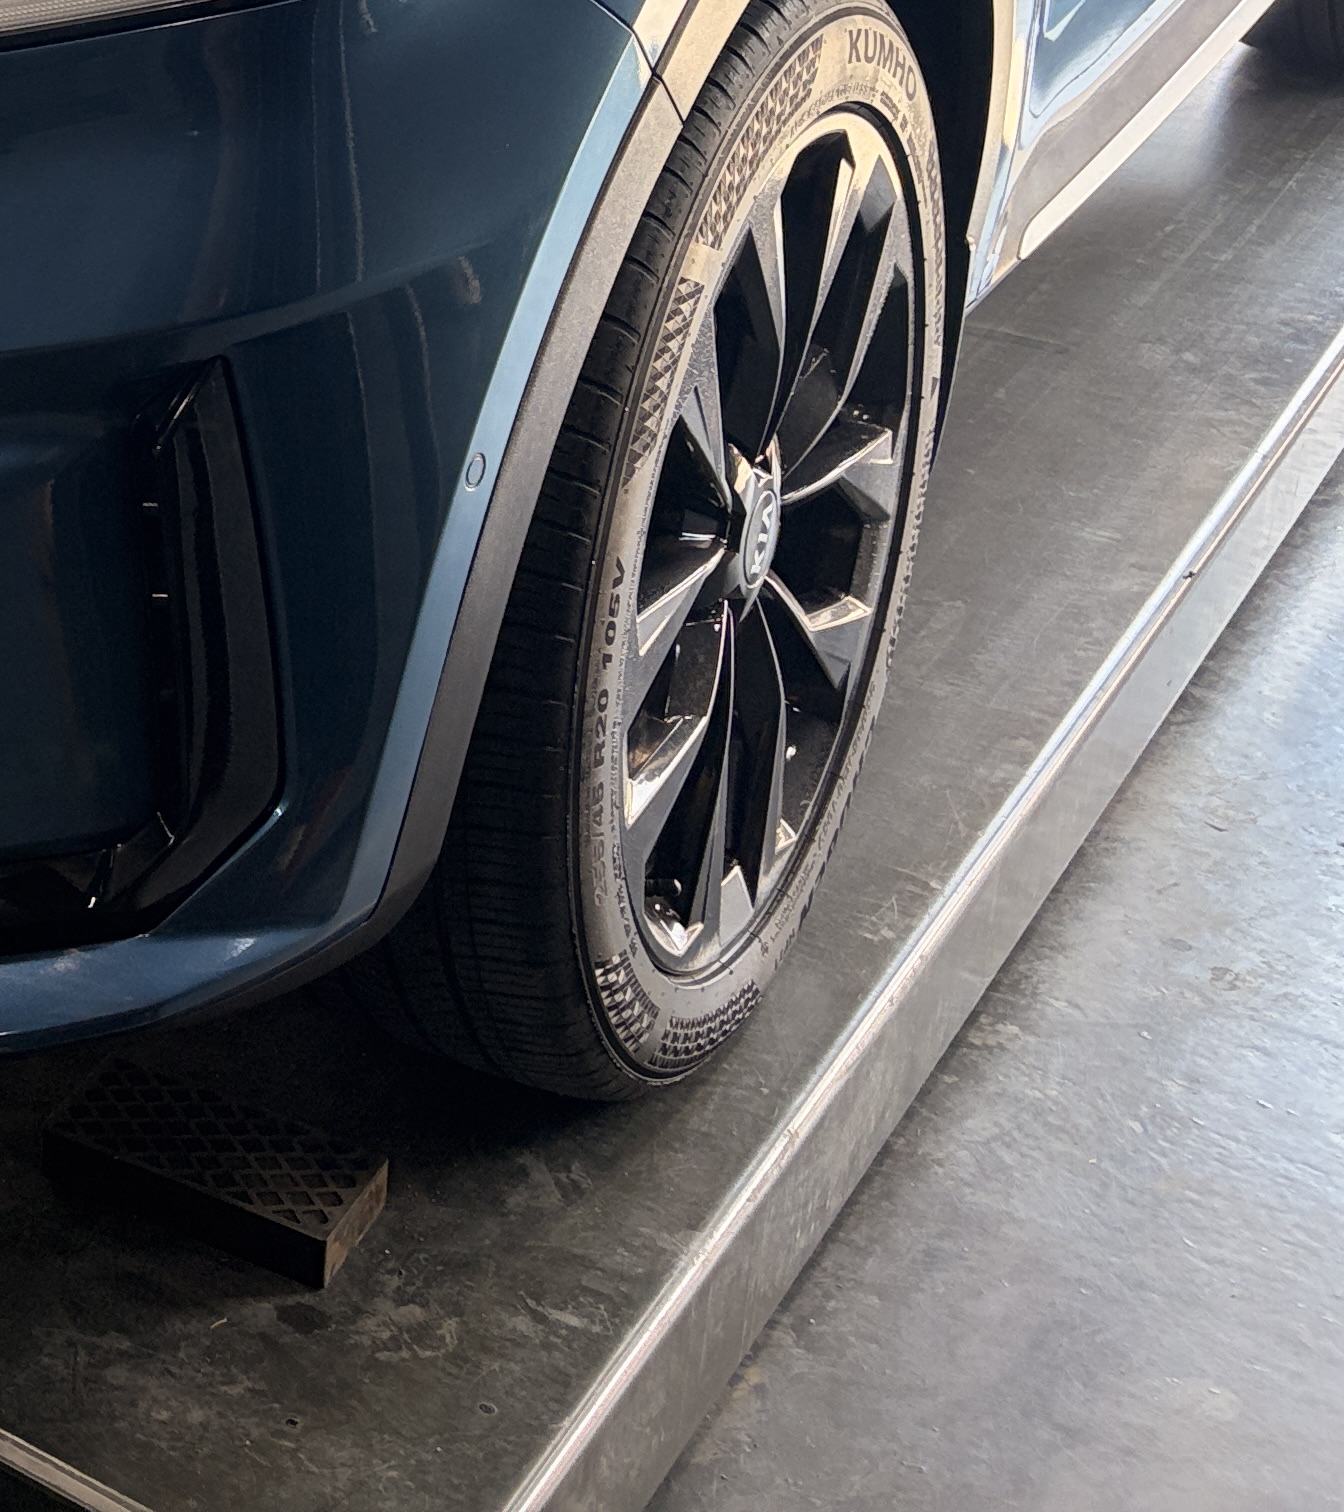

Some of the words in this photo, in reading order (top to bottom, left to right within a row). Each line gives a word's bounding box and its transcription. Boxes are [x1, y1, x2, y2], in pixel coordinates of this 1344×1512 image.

[847, 28, 917, 102] KUMHO
[593, 688, 609, 769] R20
[601, 555, 626, 671] 105V
